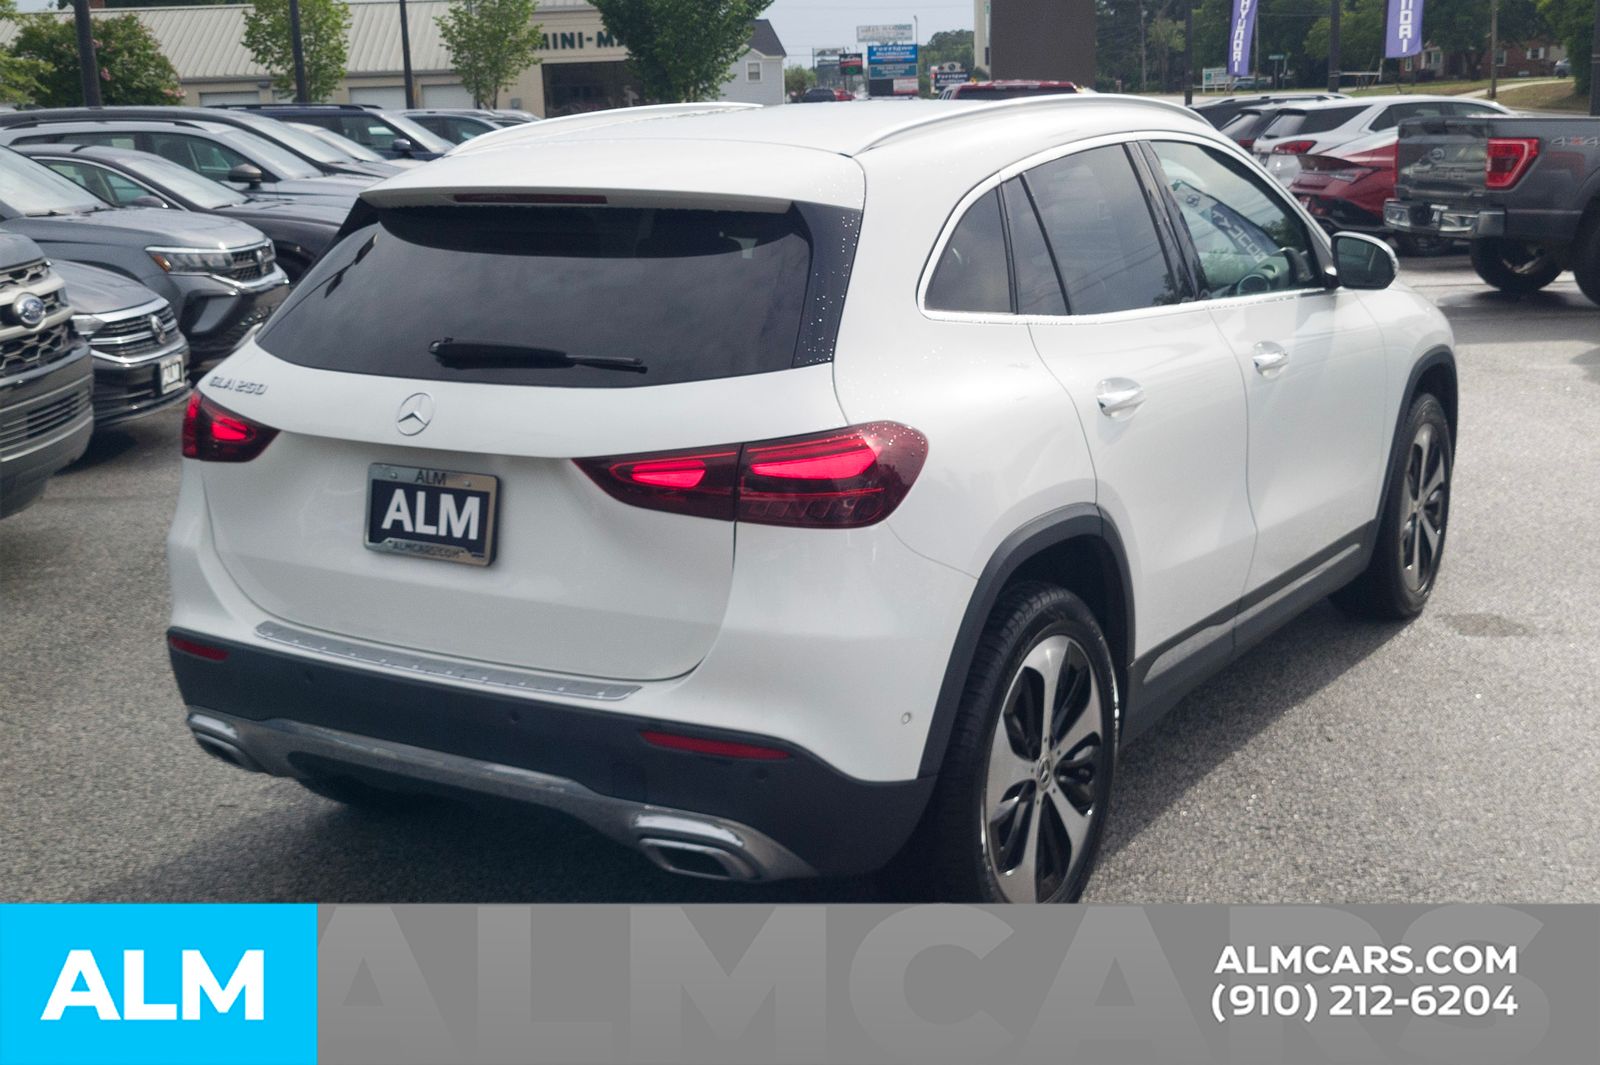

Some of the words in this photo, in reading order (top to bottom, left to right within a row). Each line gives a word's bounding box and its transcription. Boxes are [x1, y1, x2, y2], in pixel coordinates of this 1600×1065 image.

[234, 379, 269, 396] 250
[414, 469, 447, 486] ALM
[381, 488, 481, 541] ALM
